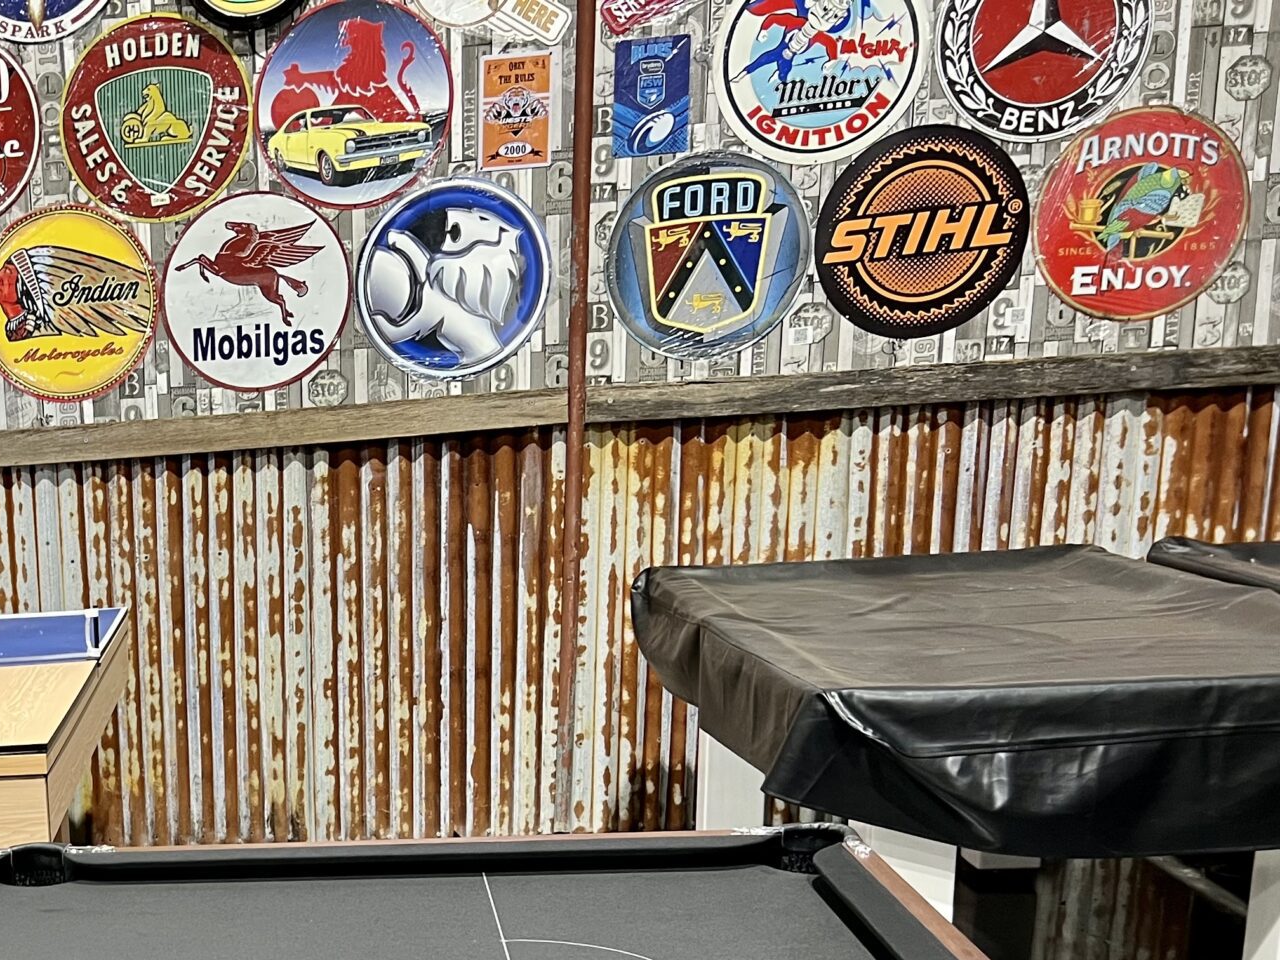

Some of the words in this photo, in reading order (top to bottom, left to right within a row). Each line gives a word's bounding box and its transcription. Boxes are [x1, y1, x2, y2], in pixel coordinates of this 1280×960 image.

[511, 0, 560, 34] HERE
[105, 32, 201, 69] HOLDEN
[508, 61, 526, 72] OBEY
[631, 43, 673, 65] BLUES
[499, 75, 512, 85] THE
[515, 73, 535, 84] RULES
[640, 79, 663, 88] NSW
[775, 75, 880, 104] Mallory
[464, 89, 476, 158] ATELIER
[746, 92, 891, 147] IGNITION
[781, 106, 810, 116] EST.
[999, 101, 1080, 134] BENZ
[72, 103, 117, 183] SALES
[185, 87, 240, 196] SERVICE
[504, 145, 527, 155] 2000
[1075, 131, 1220, 175] ARNOTT'S
[662, 181, 755, 220] FORD
[822, 203, 1013, 265] STIHL
[1057, 246, 1094, 257] SINCE
[1183, 242, 1217, 252] 1865
[52, 274, 140, 307] Indian
[13, 342, 124, 364] Motorcycles
[192, 322, 325, 366] Mobilgas
